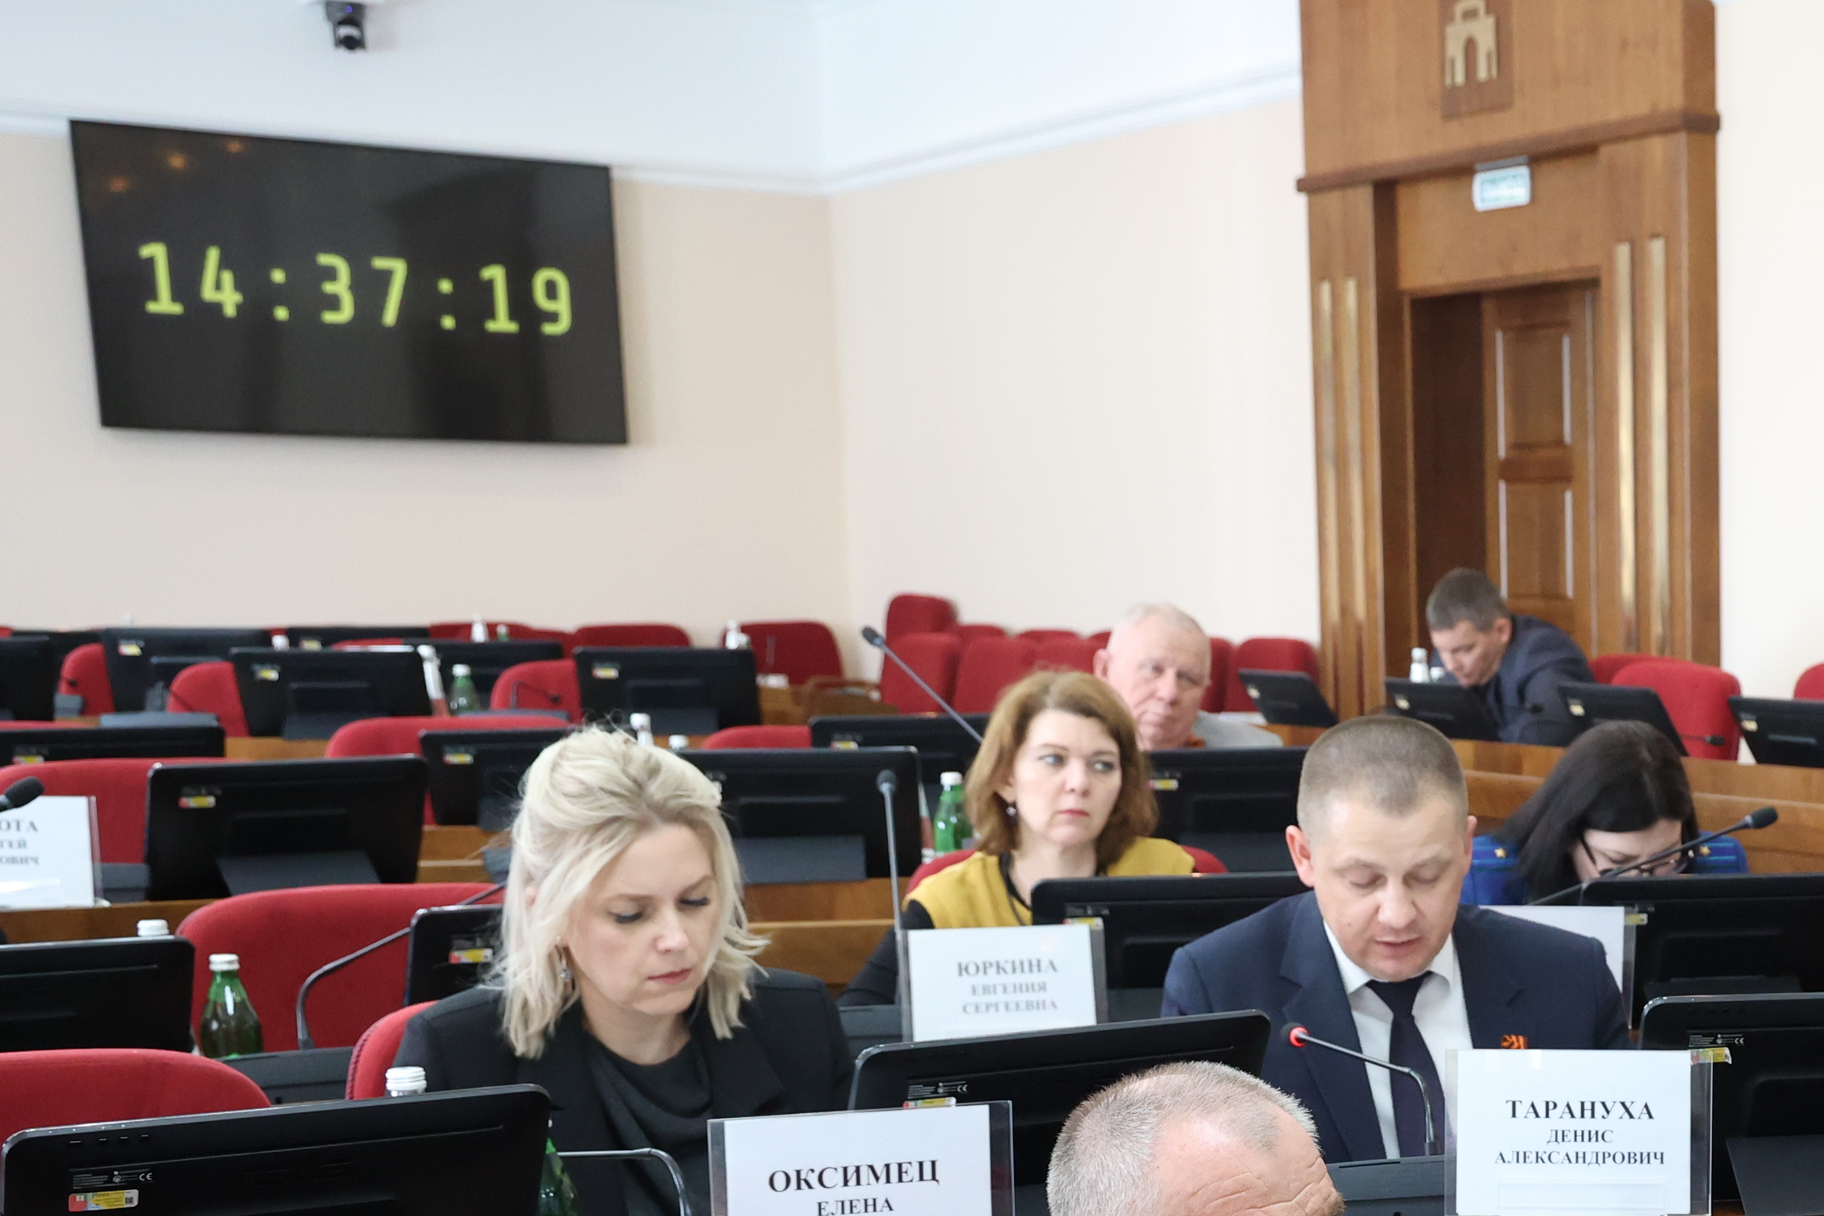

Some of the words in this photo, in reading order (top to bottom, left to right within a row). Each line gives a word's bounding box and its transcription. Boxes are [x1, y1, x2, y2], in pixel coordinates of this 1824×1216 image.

[138, 242, 574, 336] 14:37:19
[957, 957, 1059, 977] ЮРКИНА
[971, 981, 1048, 996] ЕВГЕНИЯ
[961, 999, 1059, 1014] СЕРГЕЕВНА
[1505, 1099, 1655, 1120] ТАРАНУХА
[1546, 1129, 1614, 1145] ДЕНИС
[1494, 1150, 1666, 1167] АЛЕКСАНДРОВИЧ
[768, 1159, 940, 1193] ОКСИМЕЦ
[816, 1197, 895, 1216] ЕЛЕНА
